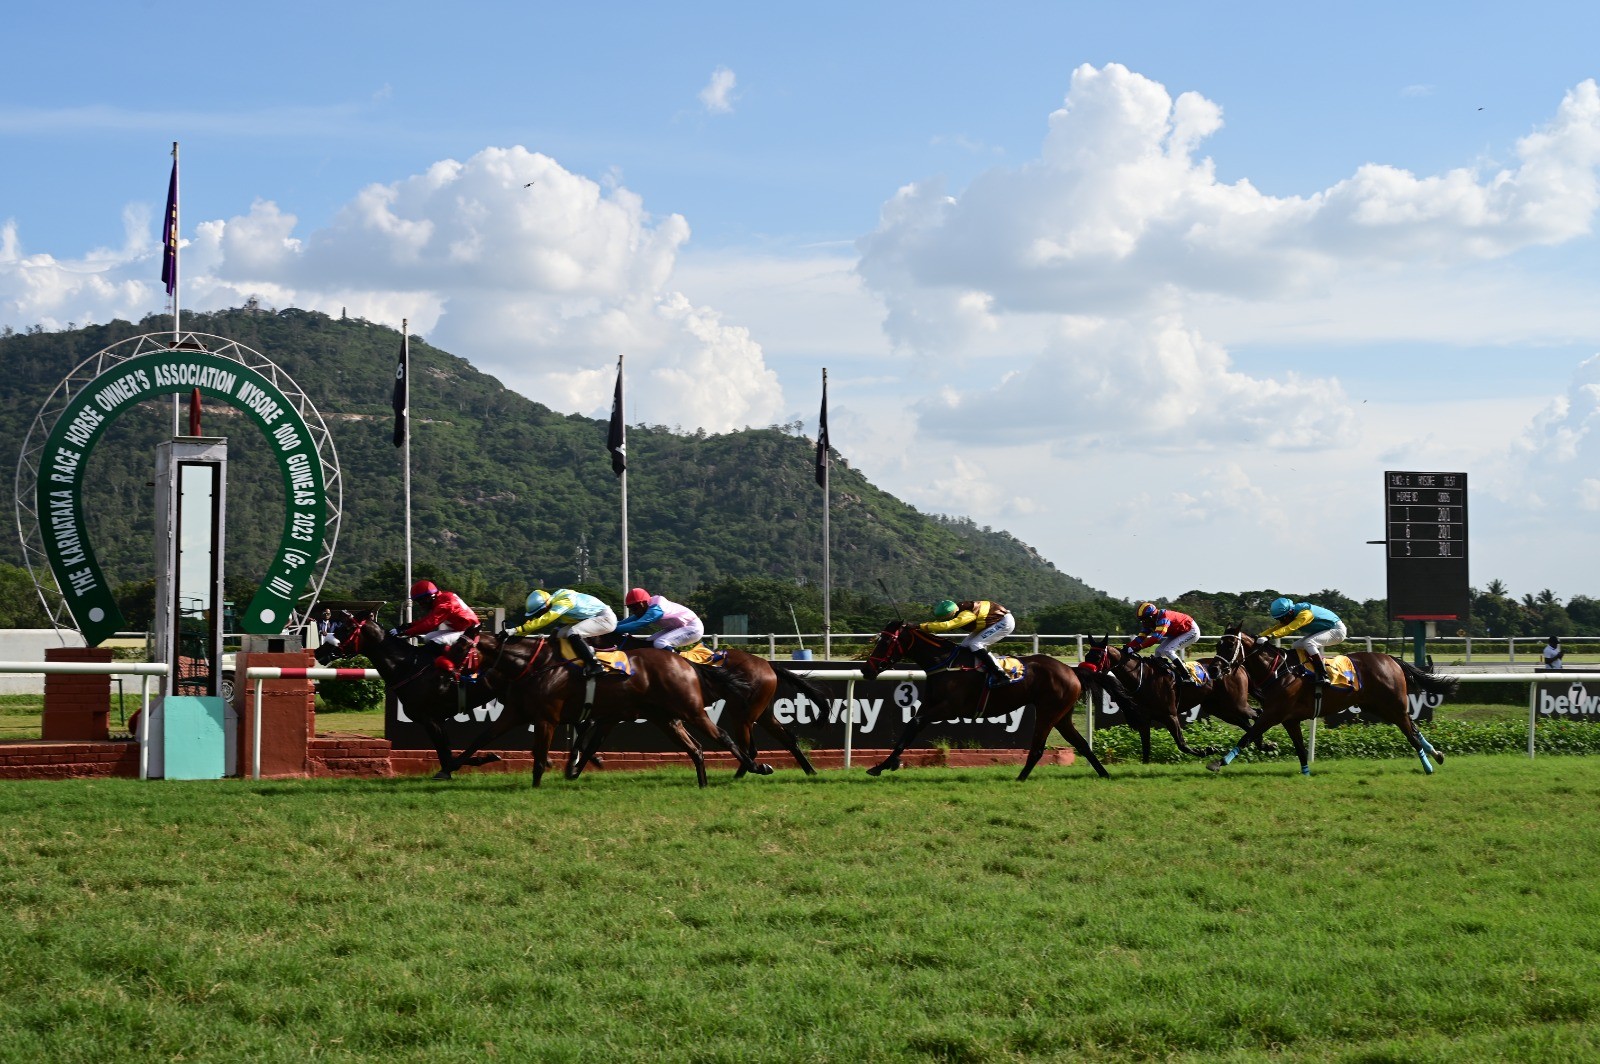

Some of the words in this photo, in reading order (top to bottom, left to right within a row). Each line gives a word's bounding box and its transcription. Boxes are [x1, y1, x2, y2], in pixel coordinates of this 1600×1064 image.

[94, 369, 151, 412] OWNER'S
[154, 363, 237, 395] ASSOCIATION
[236, 380, 285, 425] MYSORE
[64, 404, 105, 448] HORSE
[272, 422, 302, 452] 1000
[50, 447, 82, 484] RACE
[286, 453, 317, 506] GUINEAS
[50, 489, 86, 567] KARNATAKA
[291, 512, 316, 542] 2023
[68, 567, 98, 597] THE
[899, 684, 914, 707] 3
[1572, 686, 1583, 706] 7
